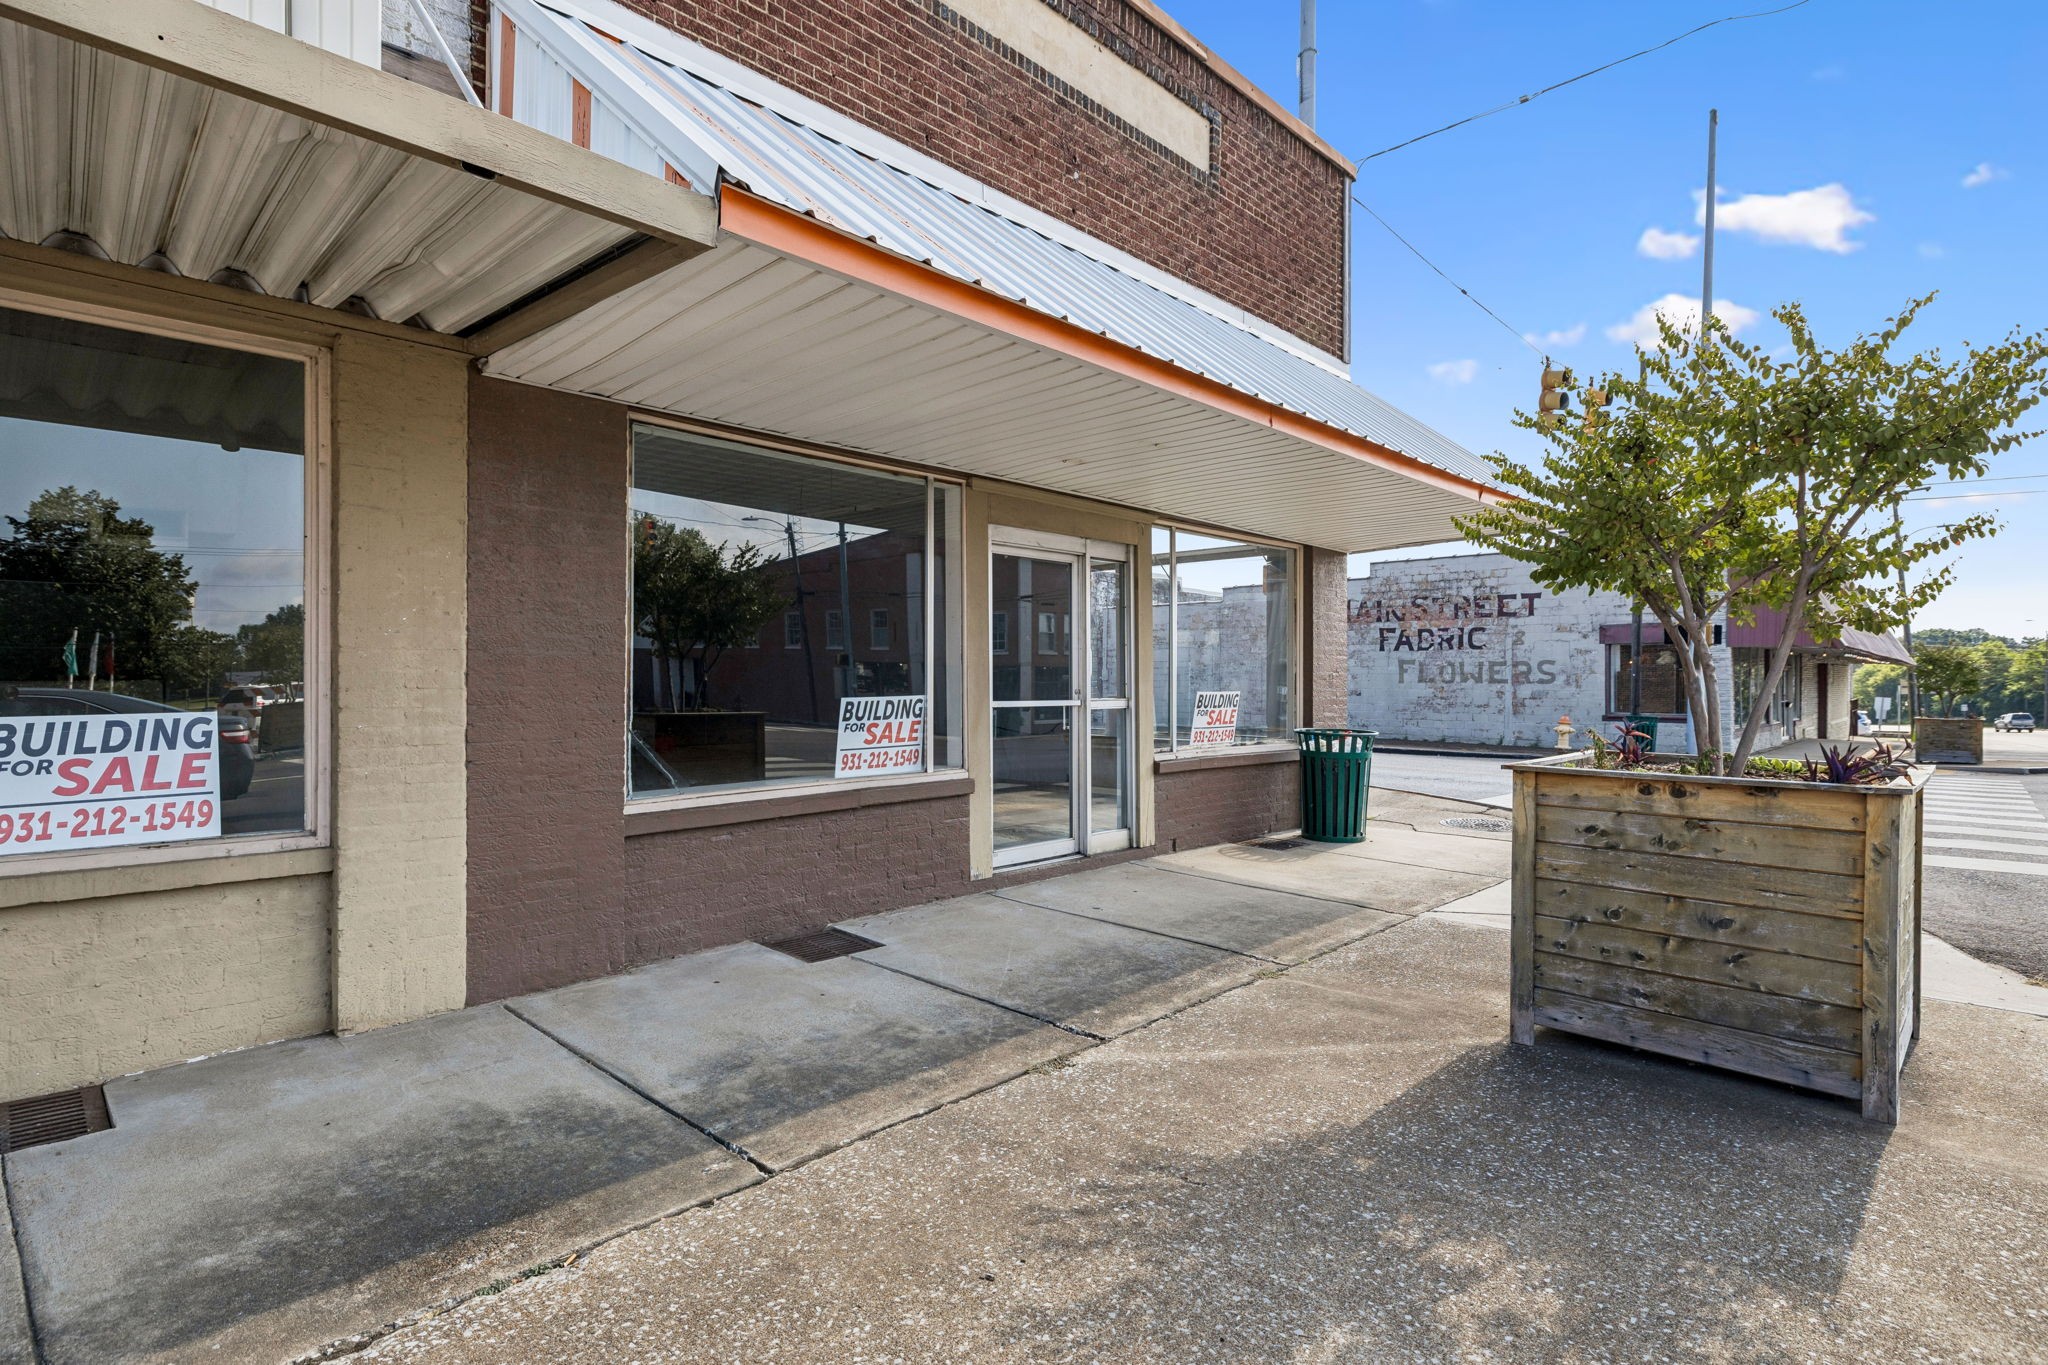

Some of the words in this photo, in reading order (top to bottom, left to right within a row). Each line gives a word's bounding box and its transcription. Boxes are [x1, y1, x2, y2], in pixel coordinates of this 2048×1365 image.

[1398, 659, 1556, 685] FLOWERS
[842, 699, 924, 722] BUILDING
[1197, 694, 1239, 708] BUILDING
[1207, 709, 1236, 725] SALE
[844, 723, 865, 733] FOR
[864, 720, 921, 745] SALE
[1193, 729, 1234, 743] 931-212-1549
[841, 749, 919, 771] 931-212-1549
[52, 752, 212, 796] SALE
[0, 800, 213, 844] 931-212-1549
